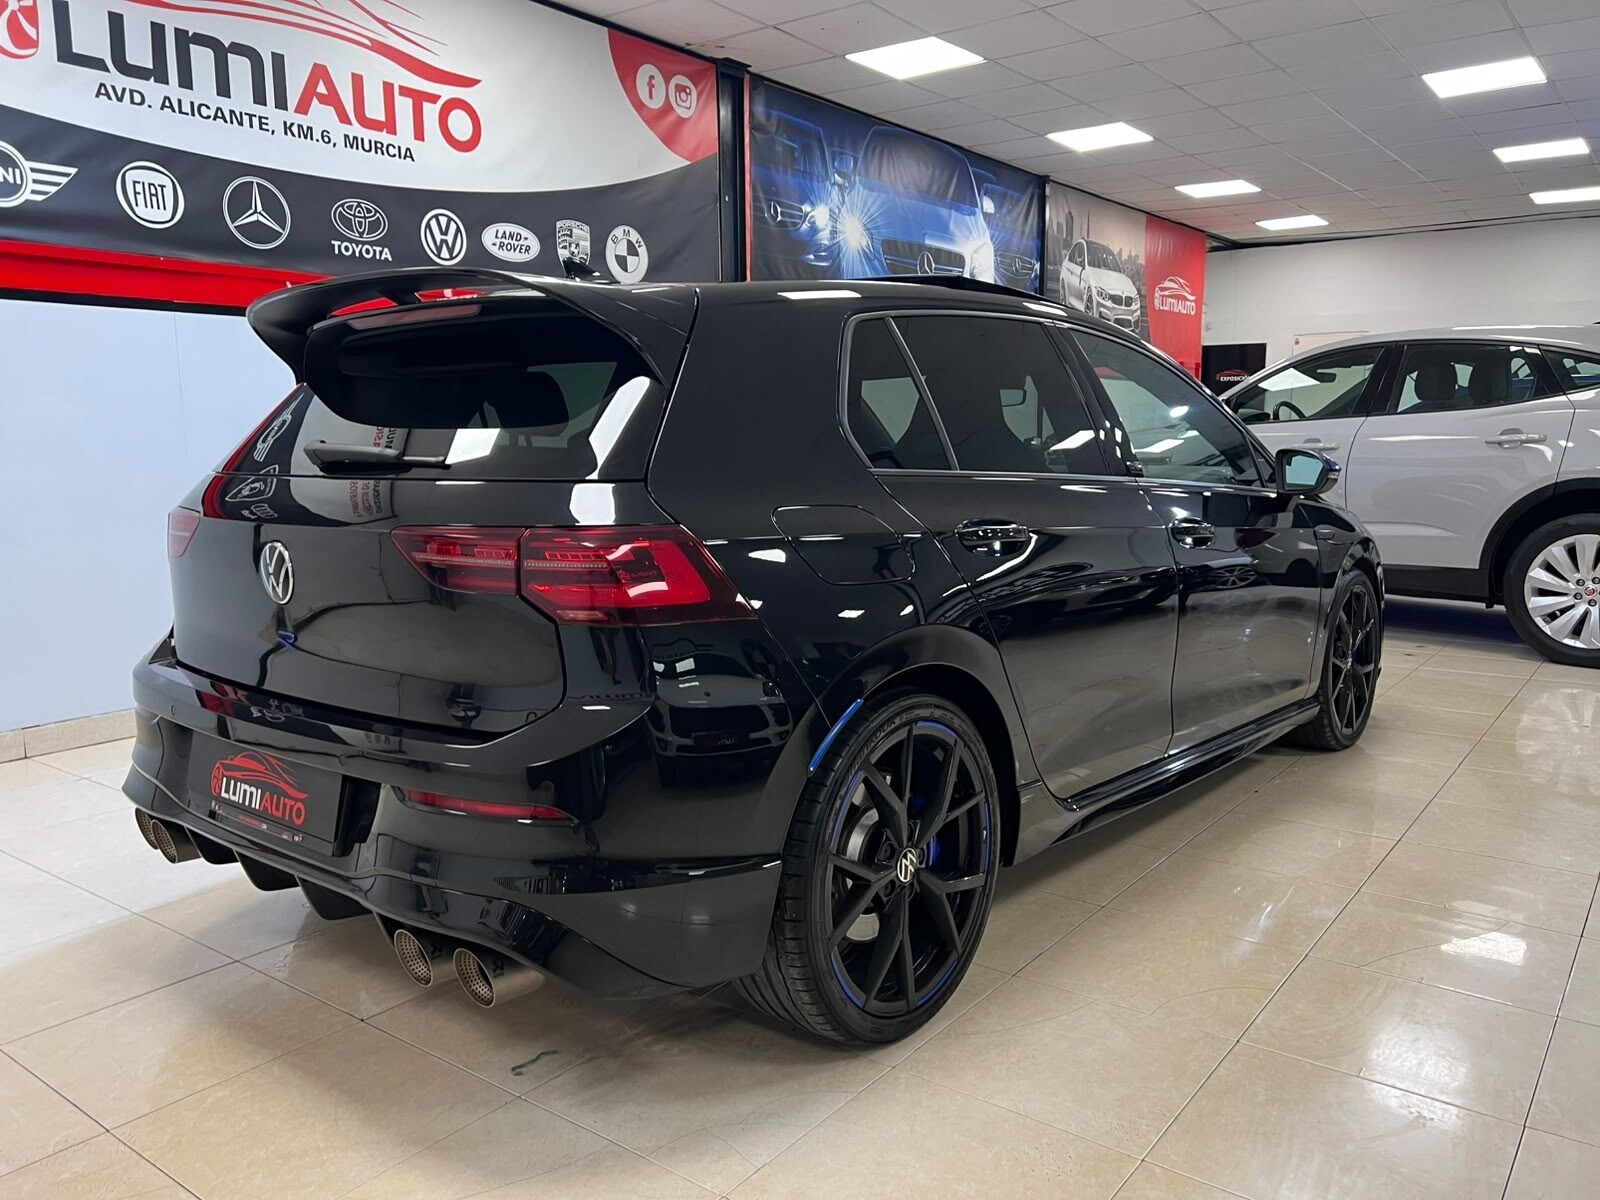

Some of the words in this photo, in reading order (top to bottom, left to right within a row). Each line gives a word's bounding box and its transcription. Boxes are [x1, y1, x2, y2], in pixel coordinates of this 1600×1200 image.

[95, 82, 152, 109] AVD.
[159, 95, 276, 135] ALICANTE,
[283, 120, 337, 148] KM.6,
[343, 133, 416, 162] MURCIA
[0, 166, 22, 185] NI
[133, 179, 168, 213] FIAT
[330, 239, 393, 261] TOYOTA
[497, 241, 531, 255] ROVER
